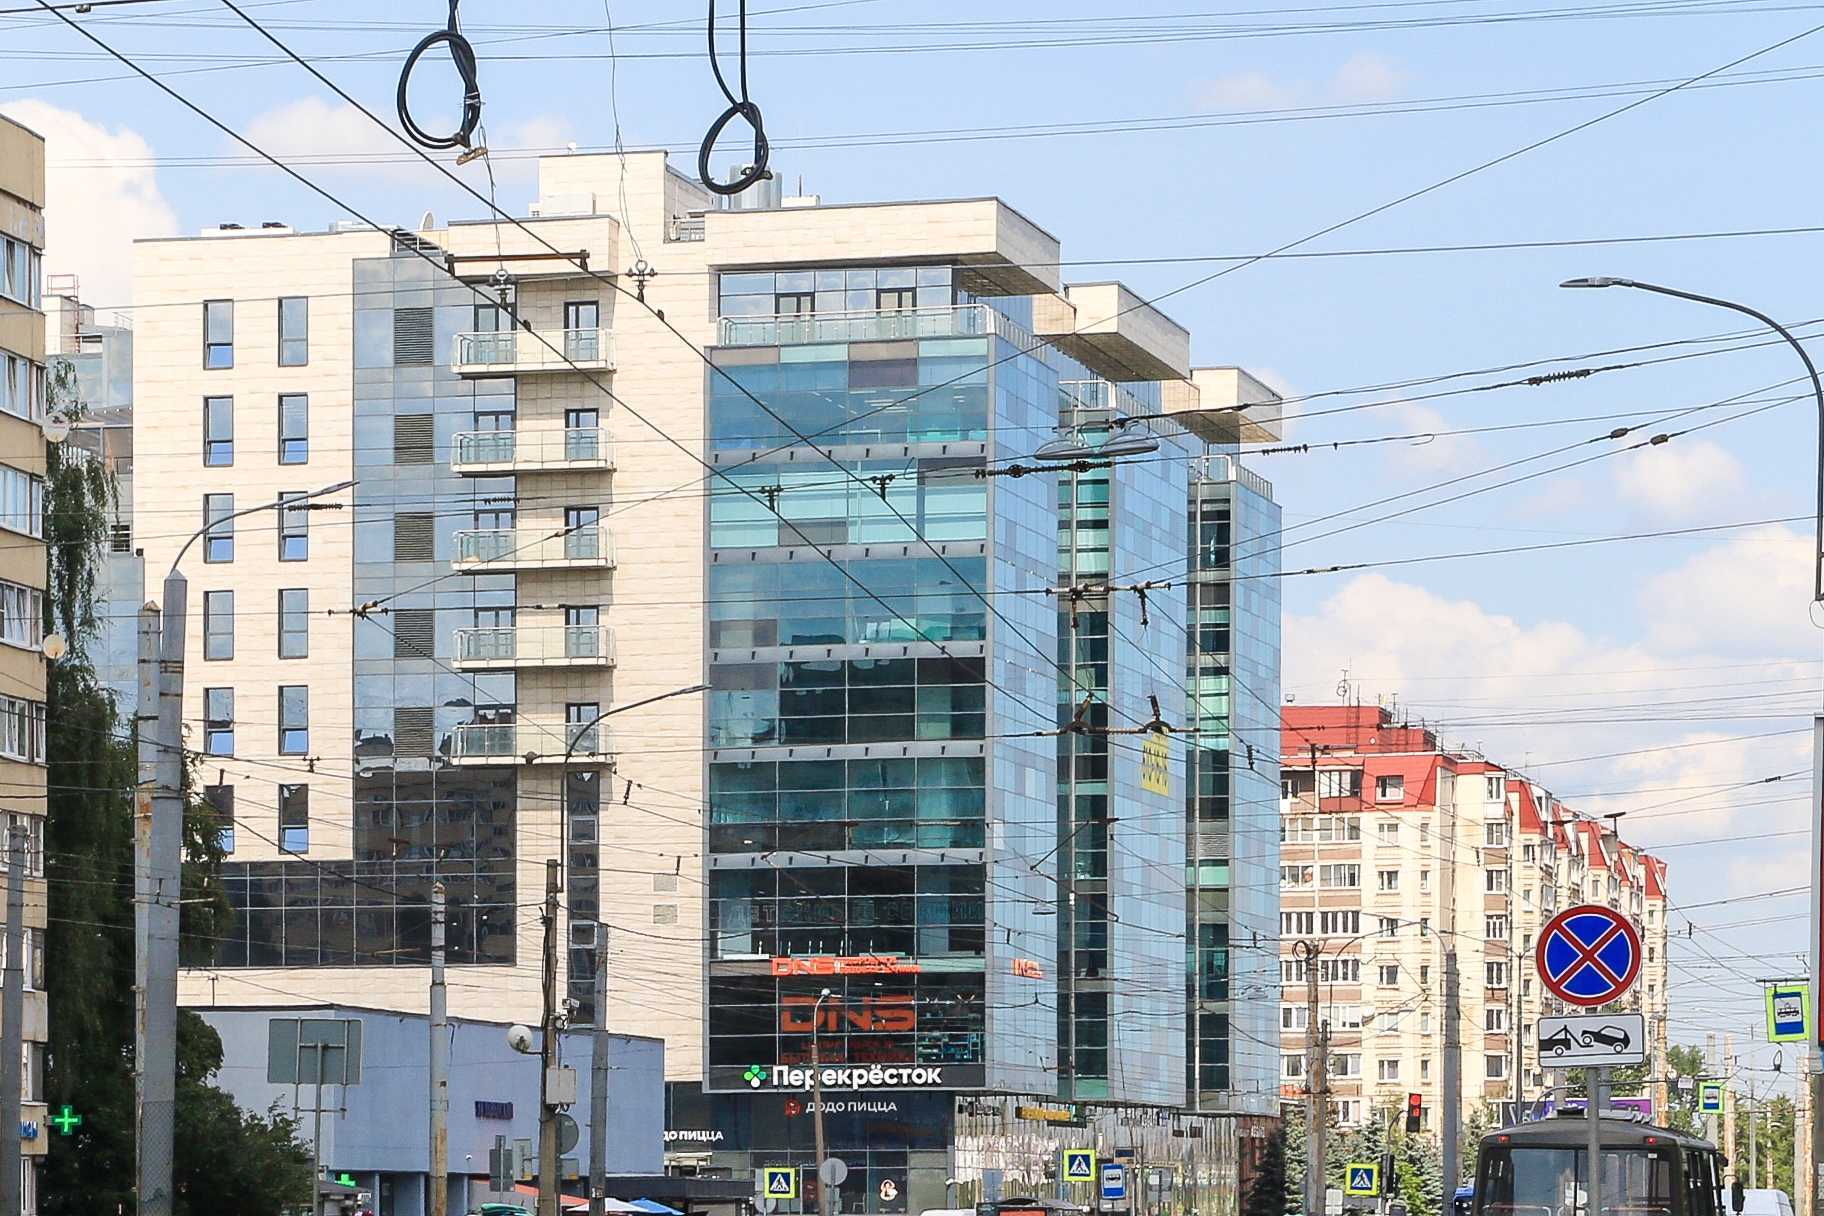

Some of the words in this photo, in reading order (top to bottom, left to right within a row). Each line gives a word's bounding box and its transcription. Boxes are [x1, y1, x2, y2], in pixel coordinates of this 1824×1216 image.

[772, 956, 836, 976] DNS
[780, 993, 916, 1032] DNS
[772, 1064, 943, 1090] Перекрёсток
[805, 1102, 845, 1114] ДОДО
[848, 1102, 898, 1114] ПИЦЦА
[679, 1130, 724, 1141] ПИЦЦА
